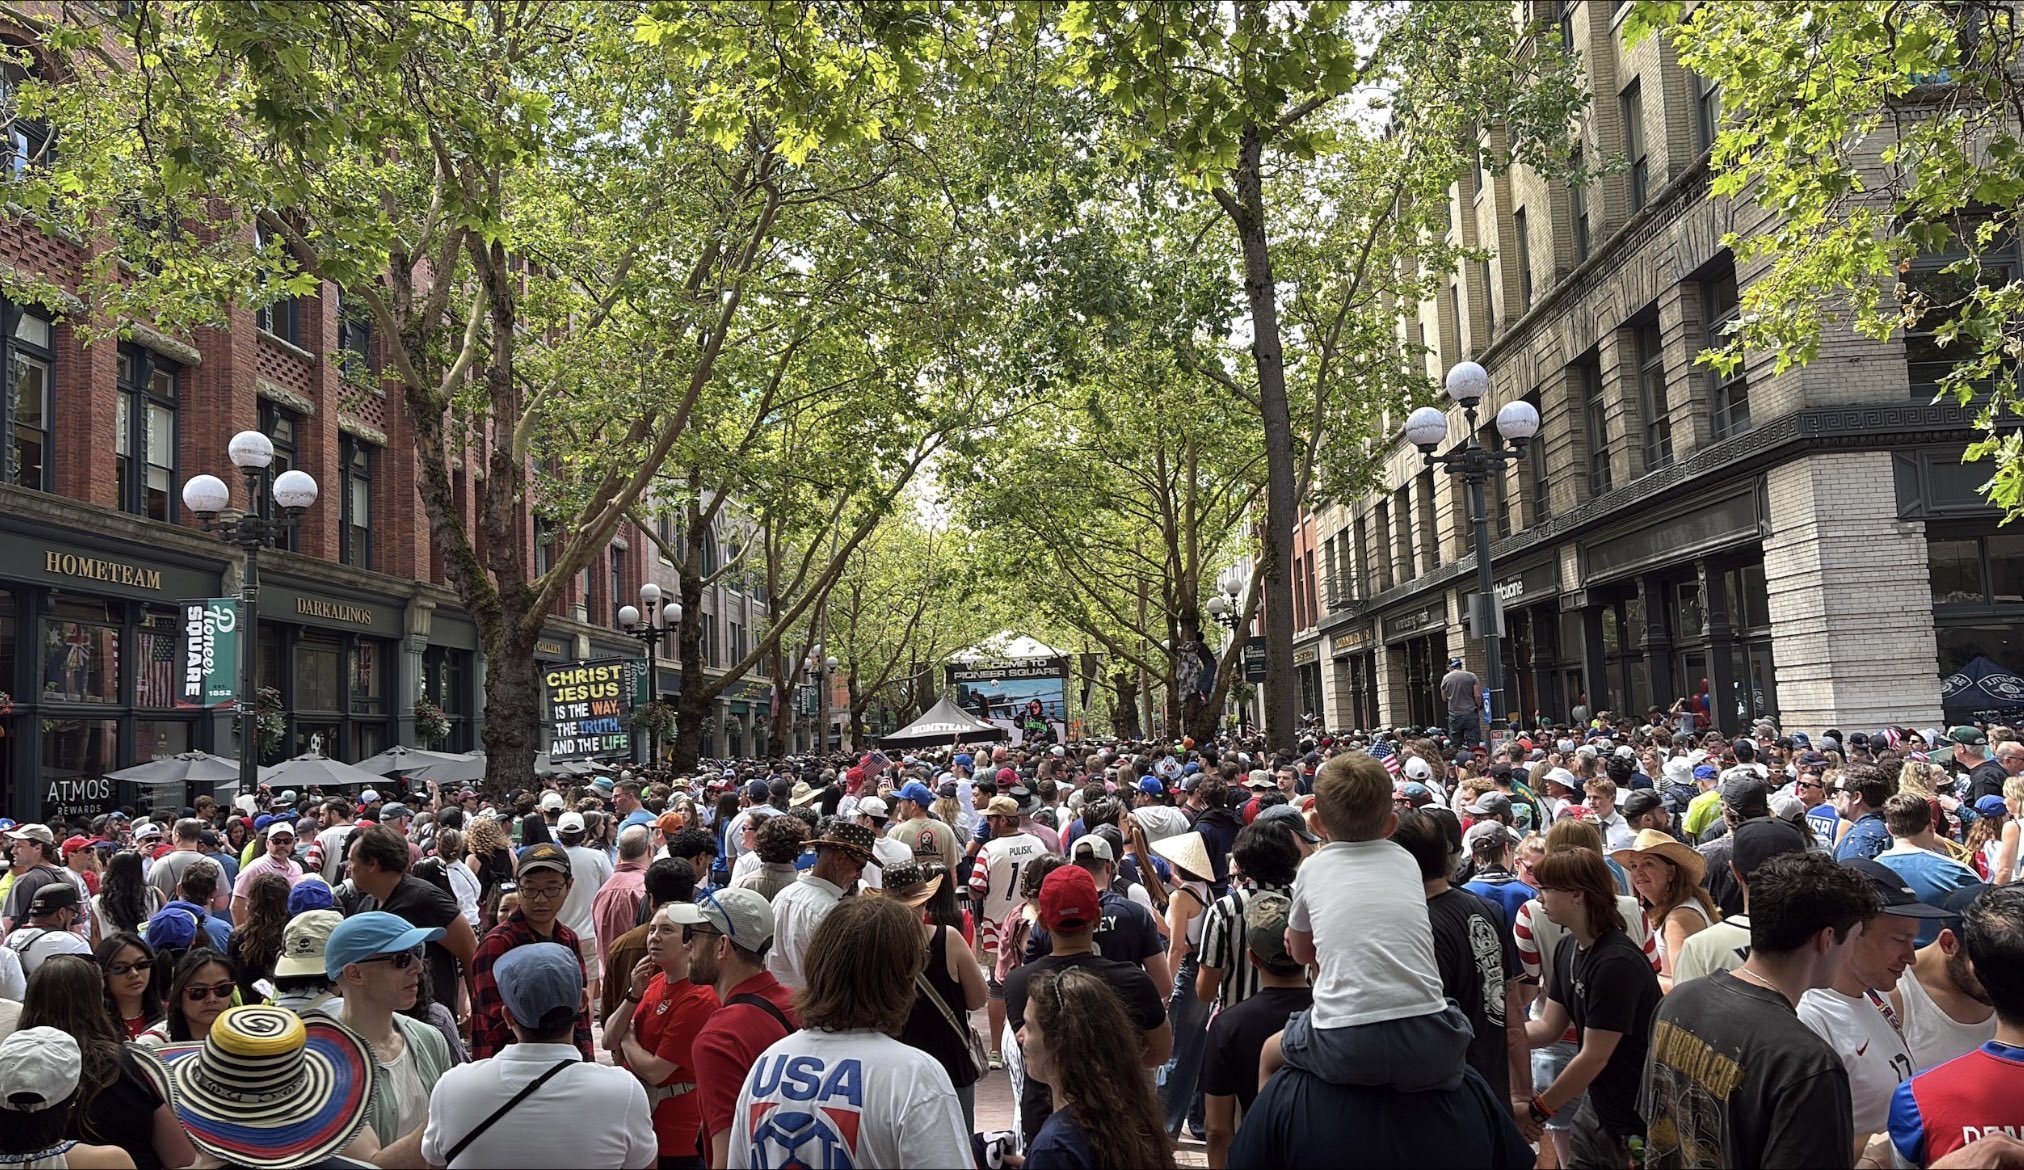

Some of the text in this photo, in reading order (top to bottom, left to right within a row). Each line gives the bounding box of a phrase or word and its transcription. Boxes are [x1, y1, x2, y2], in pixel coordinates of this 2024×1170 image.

[45, 550, 162, 589] HOMETEAM
[296, 597, 371, 625] DARKALINOS
[185, 606, 202, 696] SQUARE
[202, 605, 235, 676] Pioneer
[546, 665, 622, 687] CHRIST
[954, 667, 1060, 680] PIONEER SQUARE
[553, 682, 619, 702] JESUS
[555, 700, 620, 720] IS THE WAY,
[555, 717, 622, 737] THE TRUTH,
[911, 723, 971, 735] HOMETEAM
[551, 735, 628, 755] AND THE LIFE
[47, 779, 109, 802] ATMOS
[57, 805, 101, 815] REWARDS
[752, 1054, 863, 1108] USA
